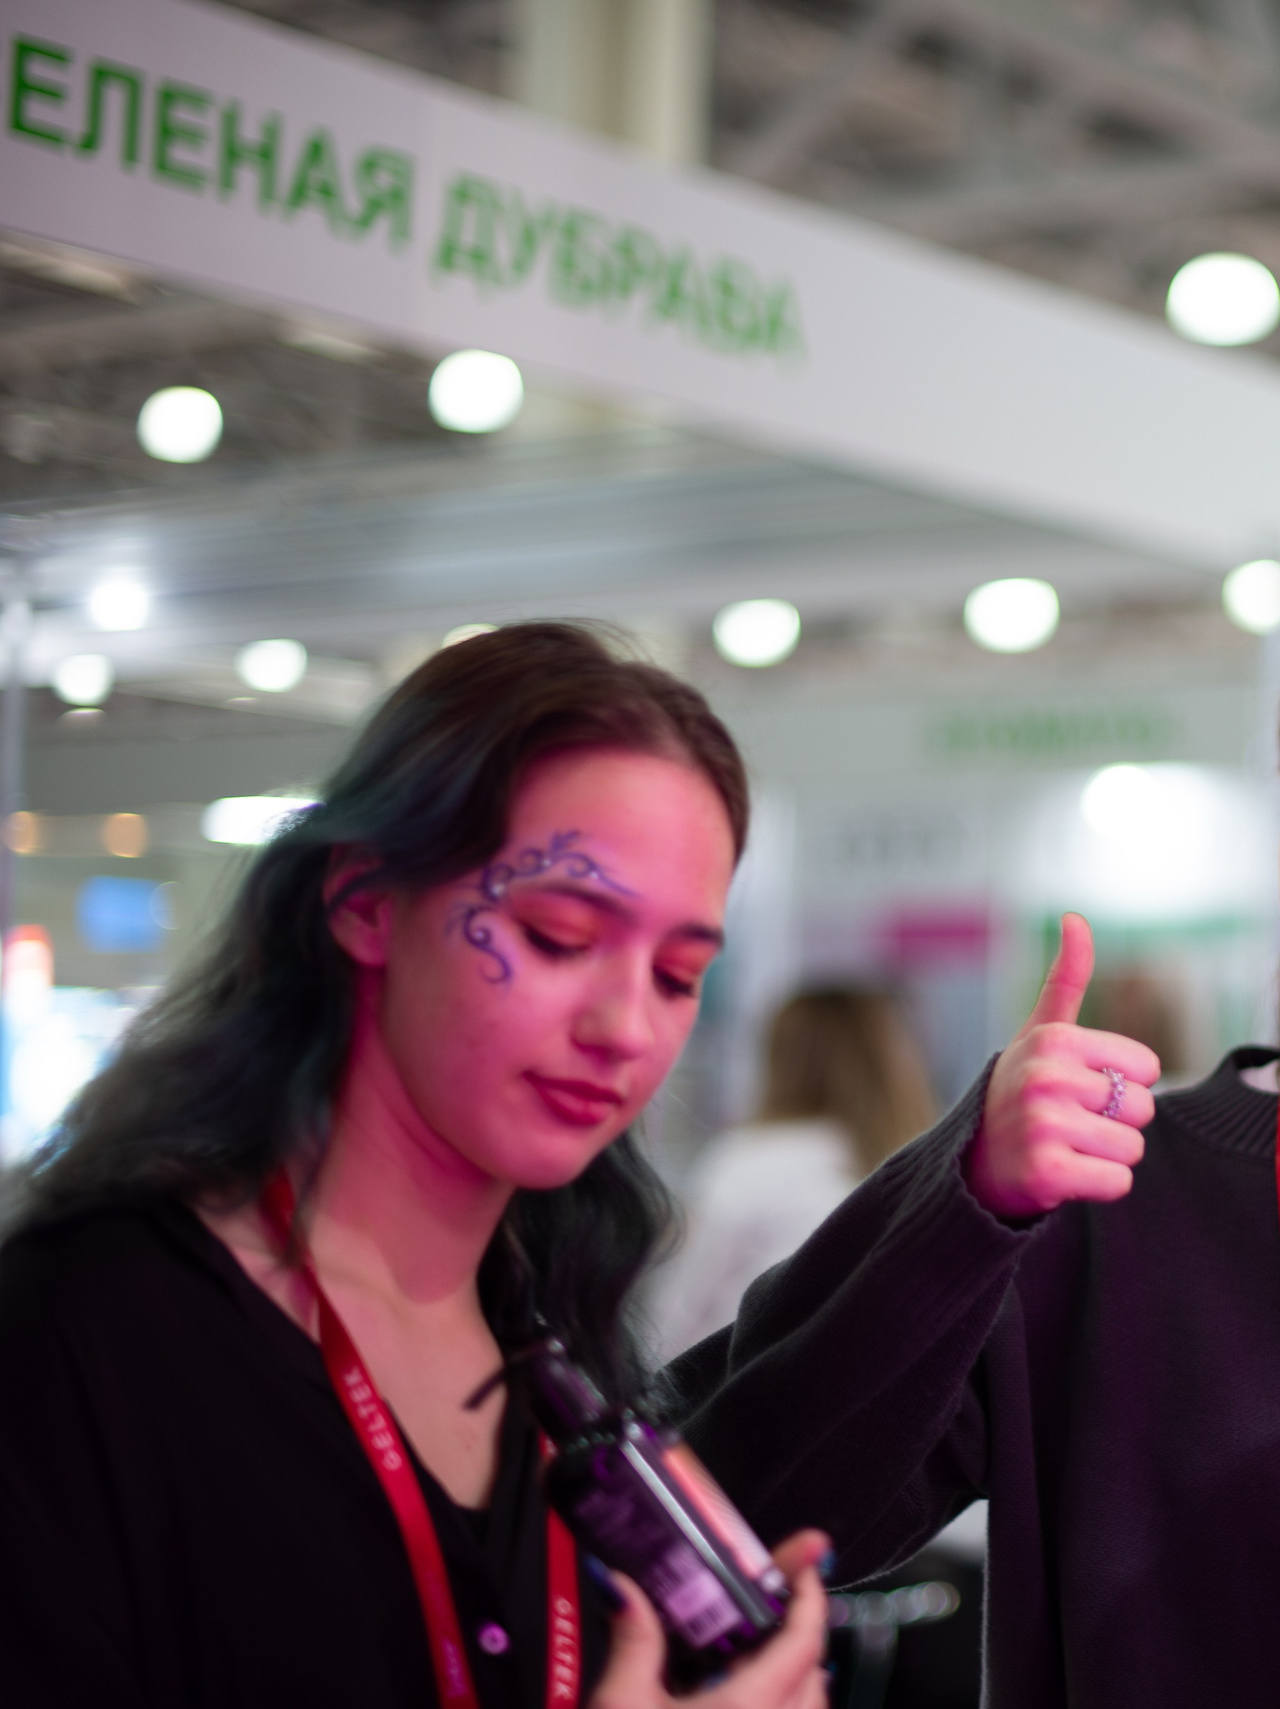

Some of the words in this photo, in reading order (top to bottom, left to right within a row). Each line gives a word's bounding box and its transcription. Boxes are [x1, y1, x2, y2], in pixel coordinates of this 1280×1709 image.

[431, 170, 807, 368] ДУБРАВА
[343, 1365, 403, 1472] GELTEK
[553, 1594, 575, 1699] GELTEK
